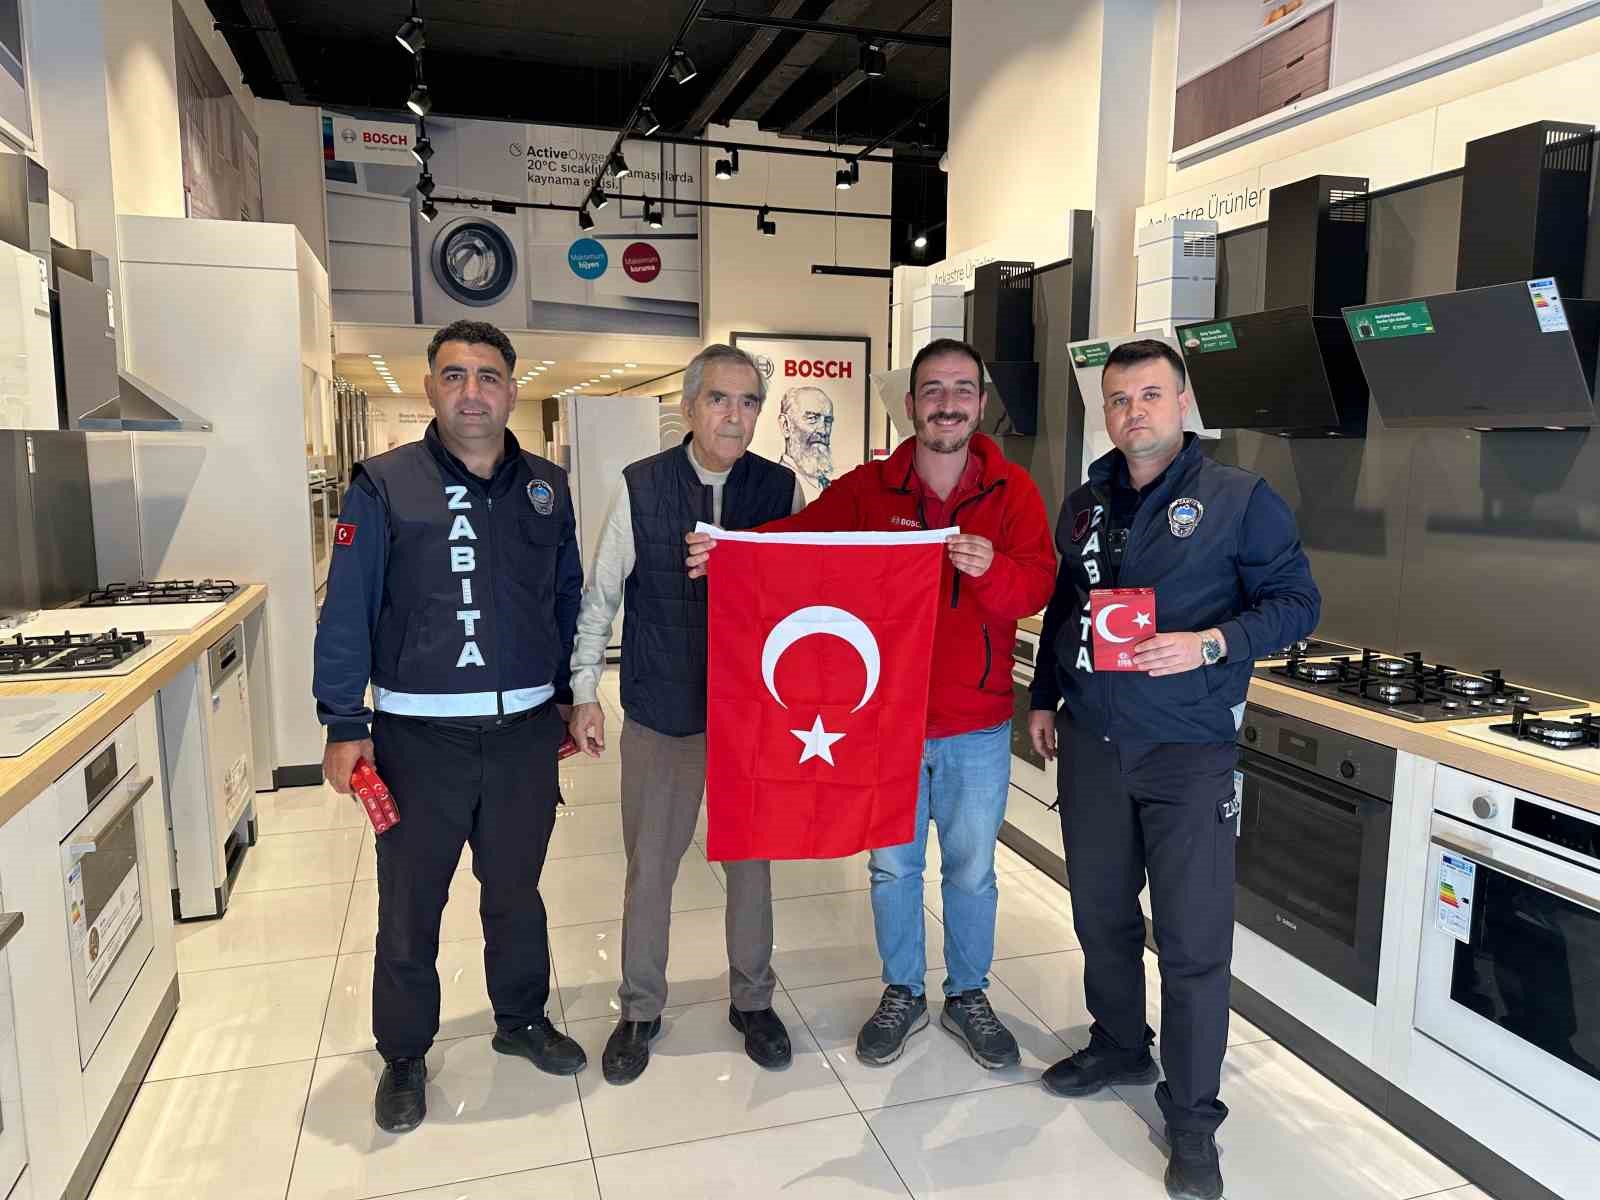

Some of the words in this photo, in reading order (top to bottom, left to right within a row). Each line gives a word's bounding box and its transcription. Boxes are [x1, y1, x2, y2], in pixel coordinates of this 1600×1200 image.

[363, 132, 408, 145] BOSCH
[527, 145, 608, 164] ActiveOxyge
[527, 172, 581, 186] kaynama
[1208, 186, 1266, 219] Ürünler
[784, 360, 852, 378] BOSCH
[900, 518, 921, 528] BOSC
[445, 486, 486, 668] ZABITA
